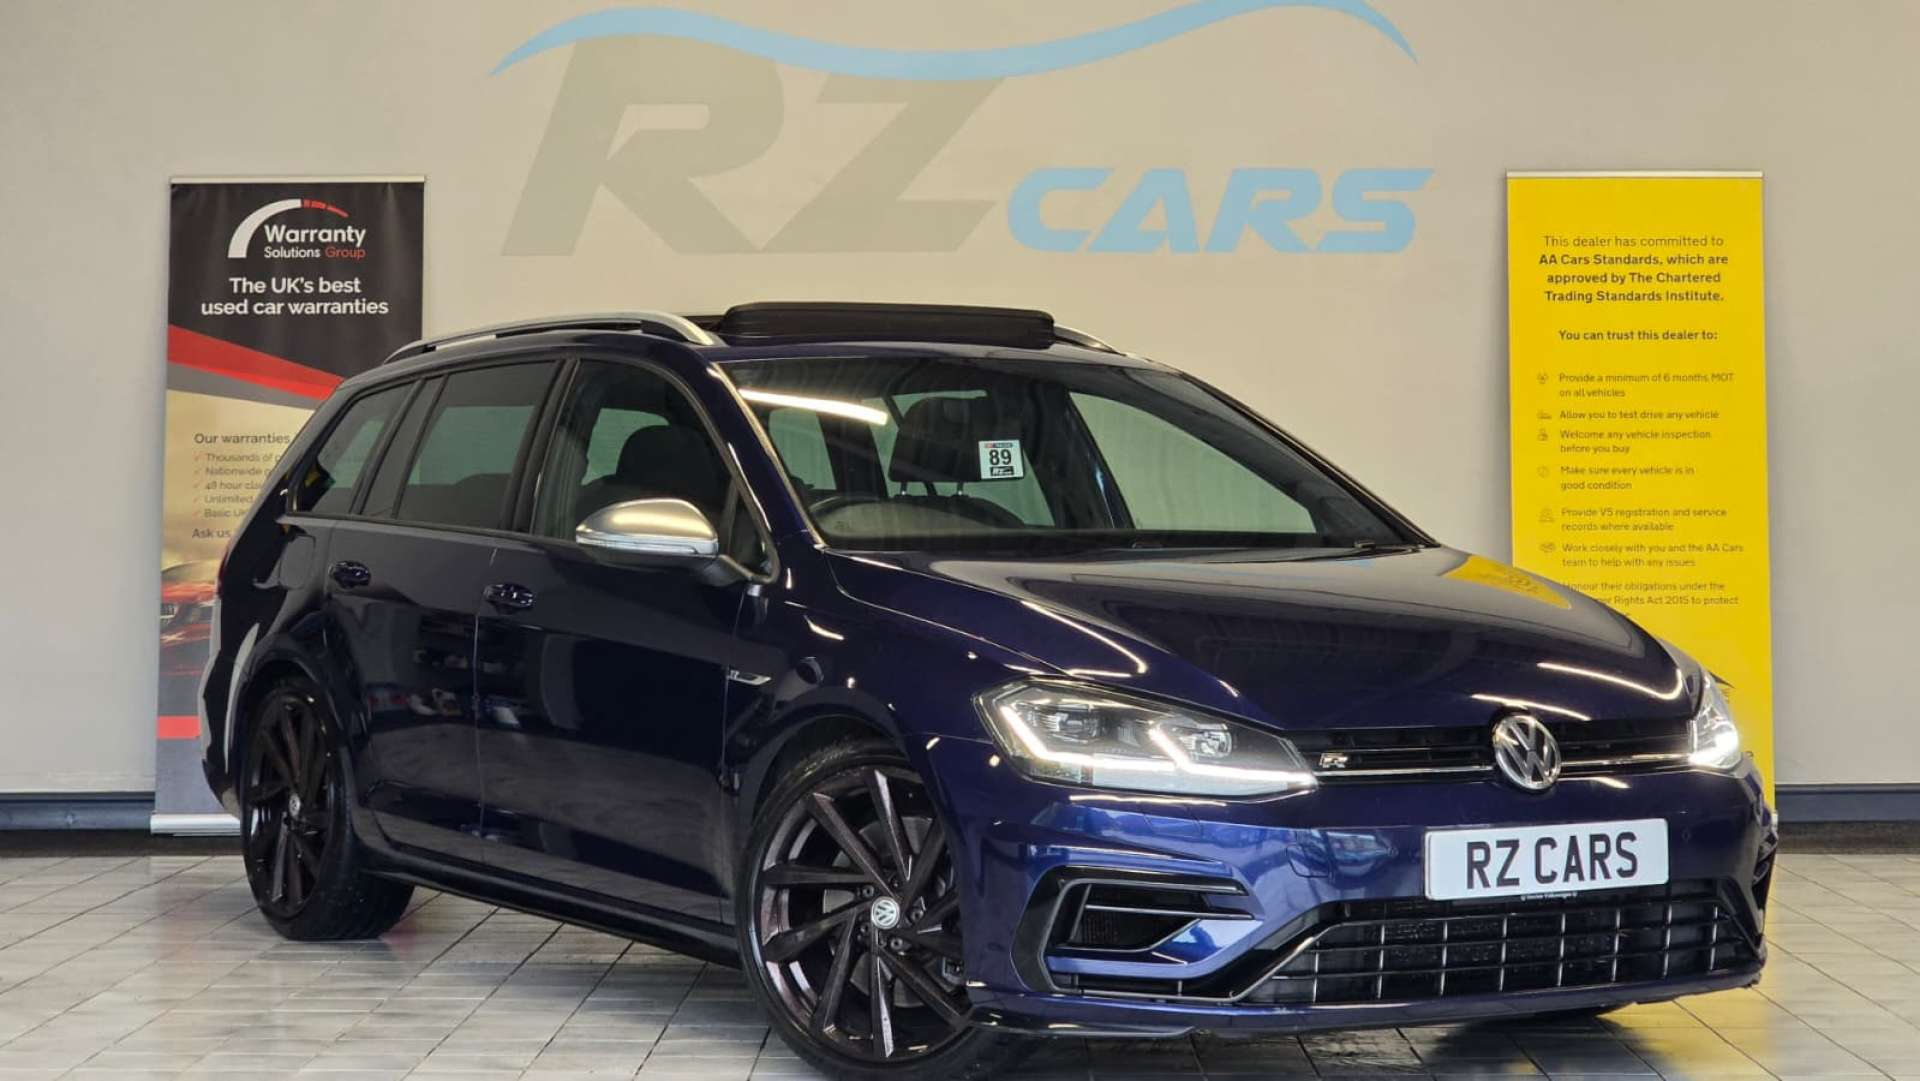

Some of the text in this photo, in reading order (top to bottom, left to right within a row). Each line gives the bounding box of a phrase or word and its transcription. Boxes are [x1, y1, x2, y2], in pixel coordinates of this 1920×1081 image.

[501, 36, 1005, 255] RZ
[1006, 167, 1433, 254] CARS
[264, 225, 366, 247] Warranty
[1544, 236, 1724, 247] This dealer has committed to
[264, 246, 366, 260] Solutions Group
[1540, 255, 1557, 264] AA
[1561, 255, 1589, 264] Cars
[1593, 254, 1663, 265] Standards,
[1667, 255, 1704, 264] which
[229, 277, 361, 293] The UK's best
[1547, 272, 1720, 285] approved by The Chartered
[1545, 291, 1724, 303] Trading Standards Institute.
[201, 298, 389, 315] used car warranties
[1559, 330, 1717, 340] You can trust this dealer to:
[194, 433, 290, 444] Our warranties
[989, 449, 1012, 465] 89
[220, 480, 241, 489] hour
[1561, 482, 1584, 491] good
[192, 529, 231, 538] Ask us
[1466, 831, 1638, 889] RZ CARS
